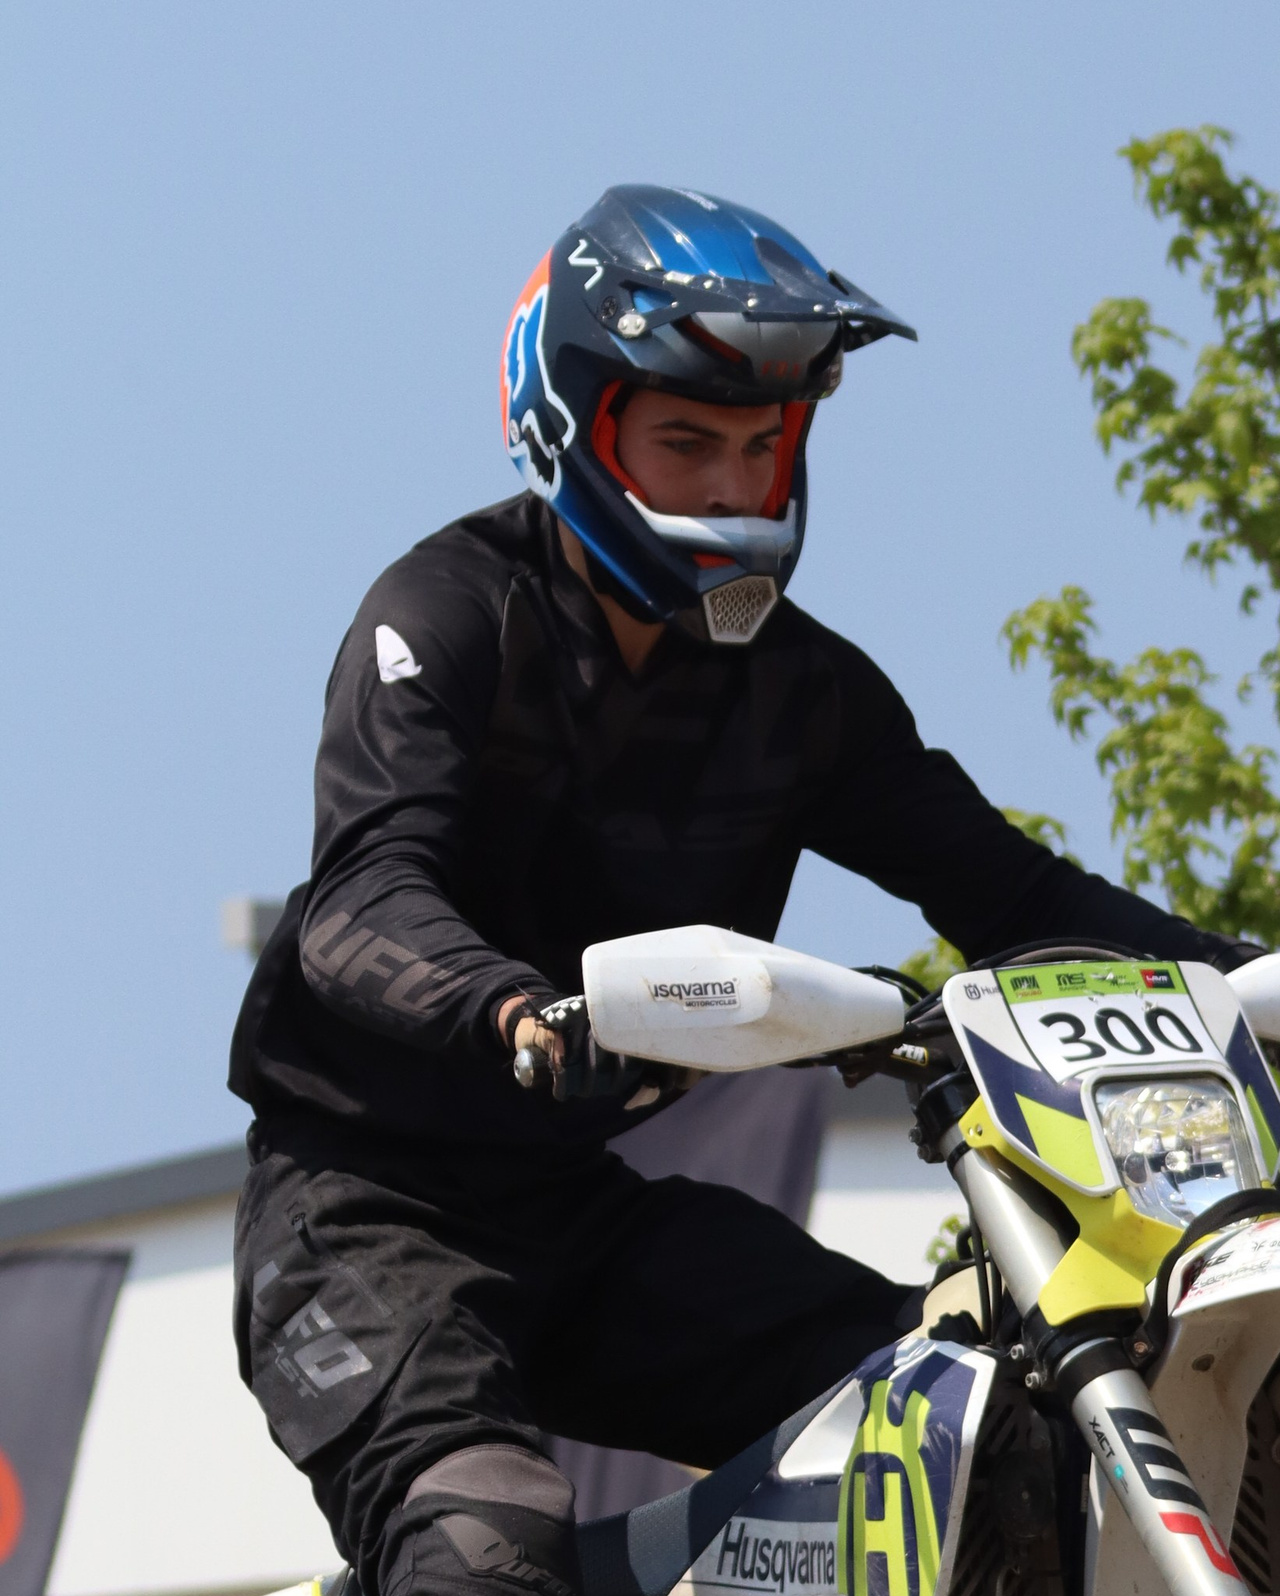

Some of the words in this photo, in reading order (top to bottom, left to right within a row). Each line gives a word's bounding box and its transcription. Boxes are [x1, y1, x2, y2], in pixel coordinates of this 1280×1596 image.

[685, 999, 737, 1008] MOTORCYCLES
[1038, 1006, 1204, 1063] 300
[1088, 1414, 1116, 1459] XACT
[716, 1520, 835, 1594] Husqvarna
